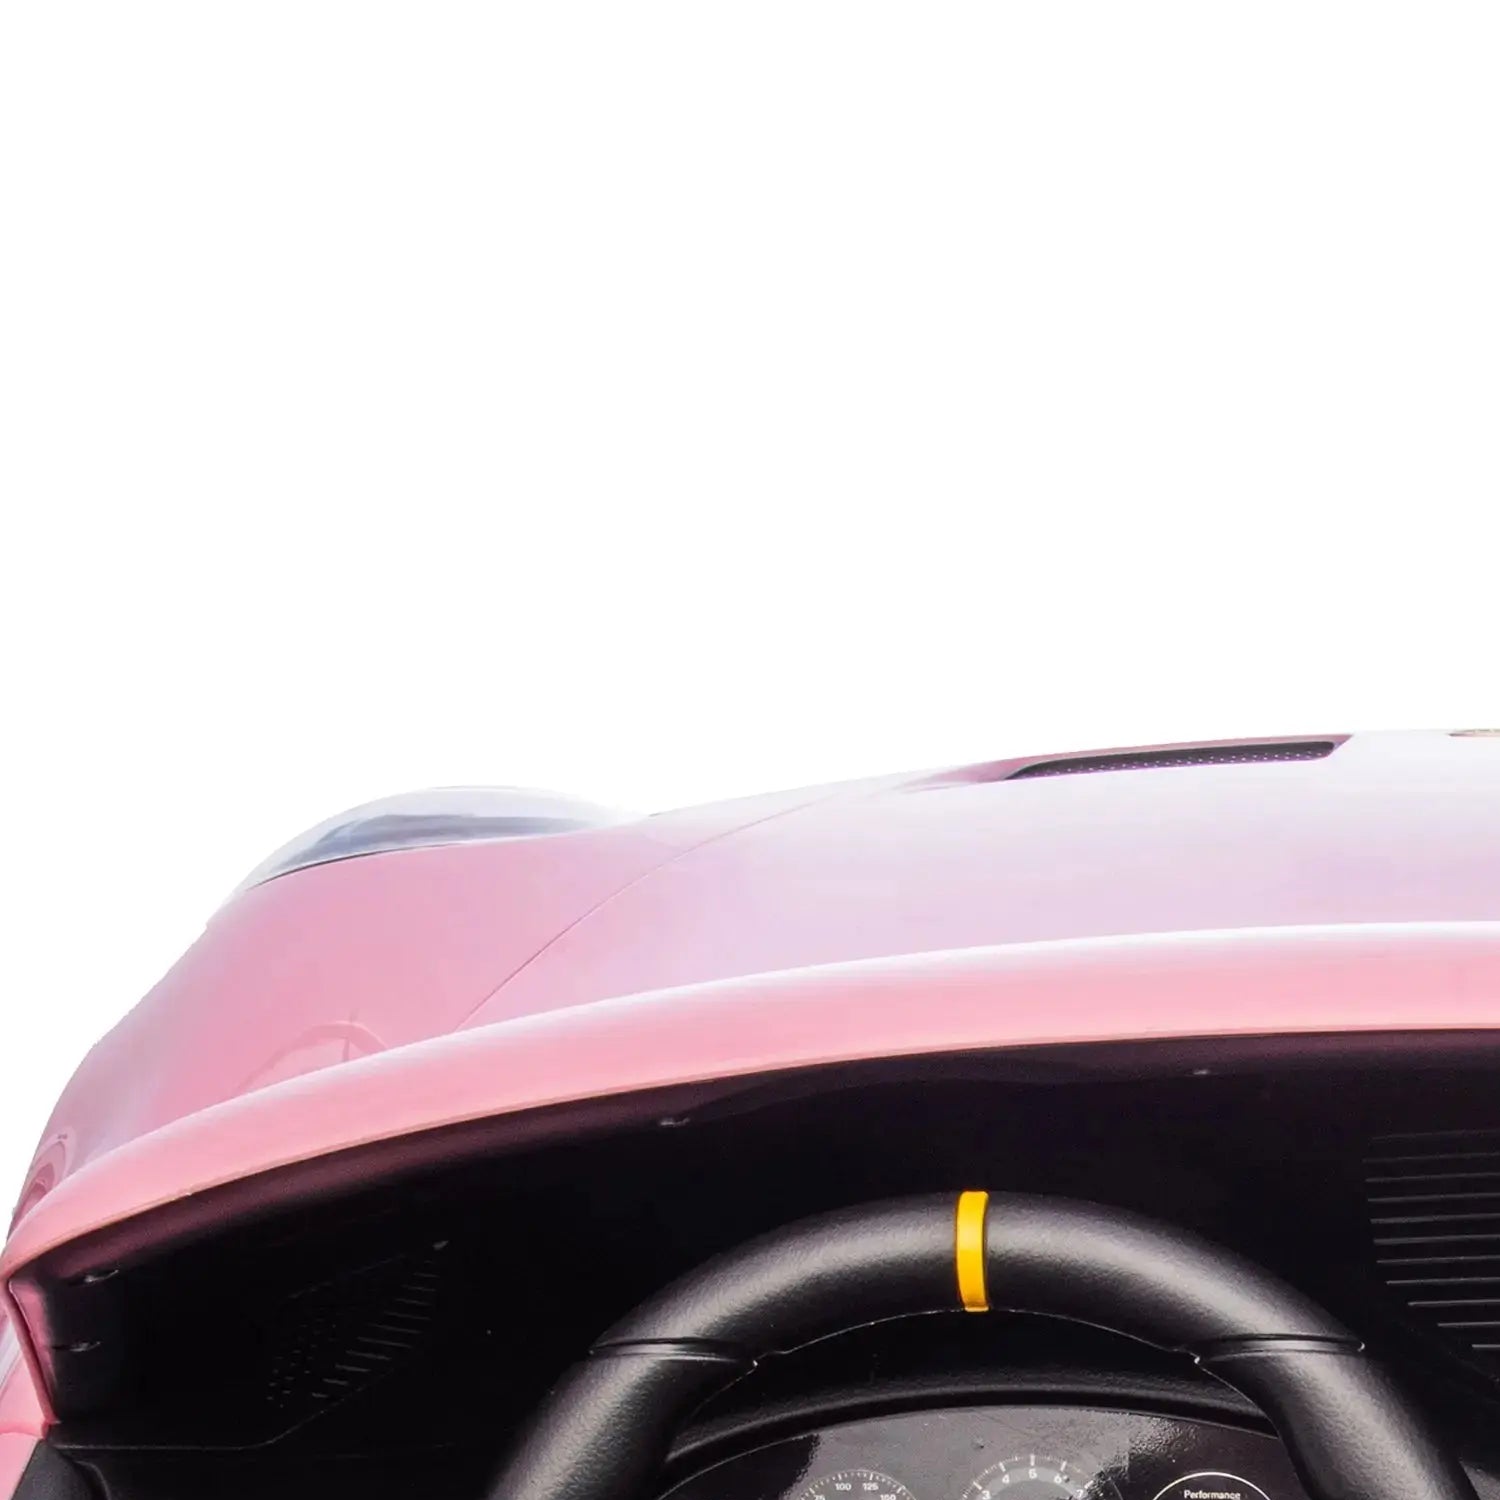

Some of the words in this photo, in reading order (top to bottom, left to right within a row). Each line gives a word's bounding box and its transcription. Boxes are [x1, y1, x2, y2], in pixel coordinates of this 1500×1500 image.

[1002, 1475, 1010, 1484] 4
[1053, 1475, 1061, 1484] 6
[835, 1483, 852, 1491] 100
[862, 1483, 879, 1491] 125
[982, 1490, 991, 1500] 3
[1184, 1489, 1241, 1499] Performance
